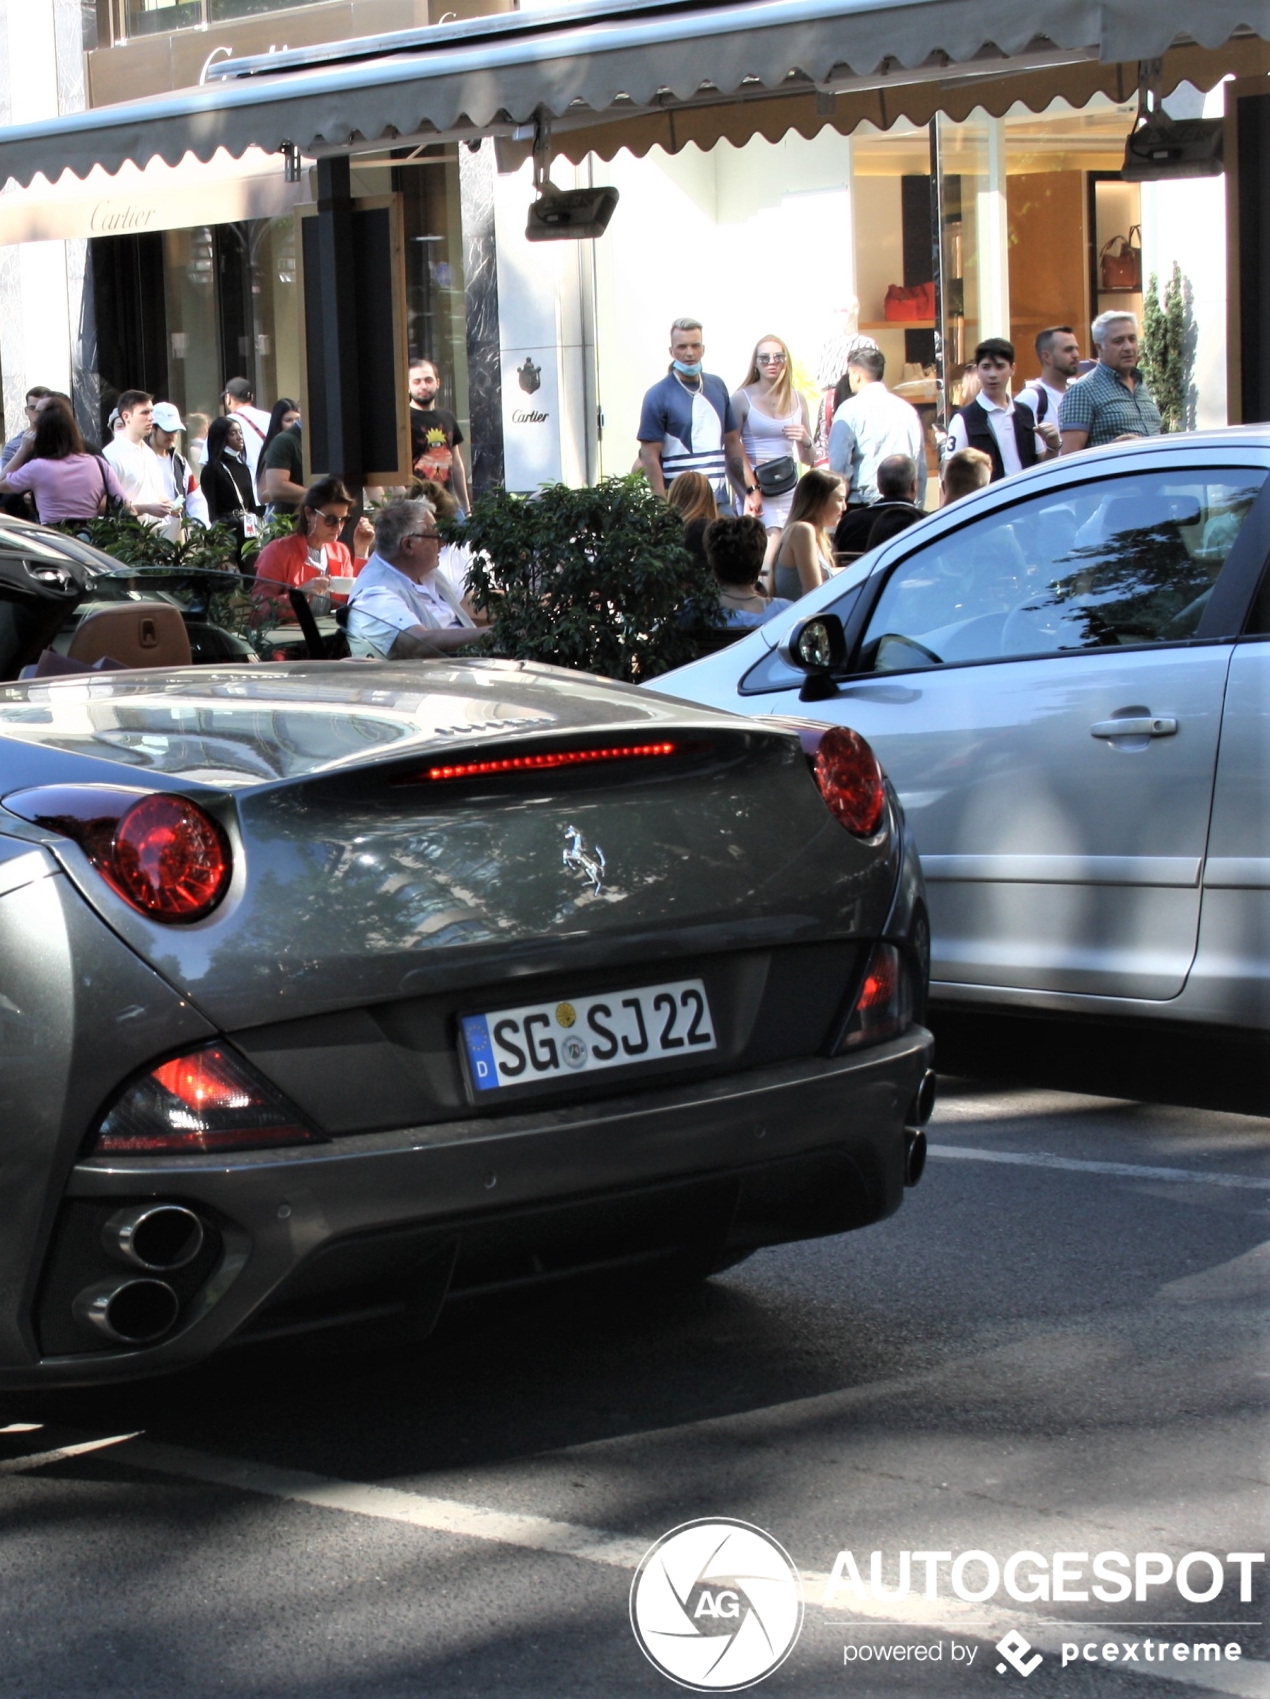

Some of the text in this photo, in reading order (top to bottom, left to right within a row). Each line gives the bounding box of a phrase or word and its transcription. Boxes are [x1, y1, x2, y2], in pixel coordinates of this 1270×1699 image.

[91, 200, 155, 231] Cartier
[512, 409, 550, 423] Cartier
[493, 1014, 559, 1077] SG
[477, 1061, 488, 1077] D
